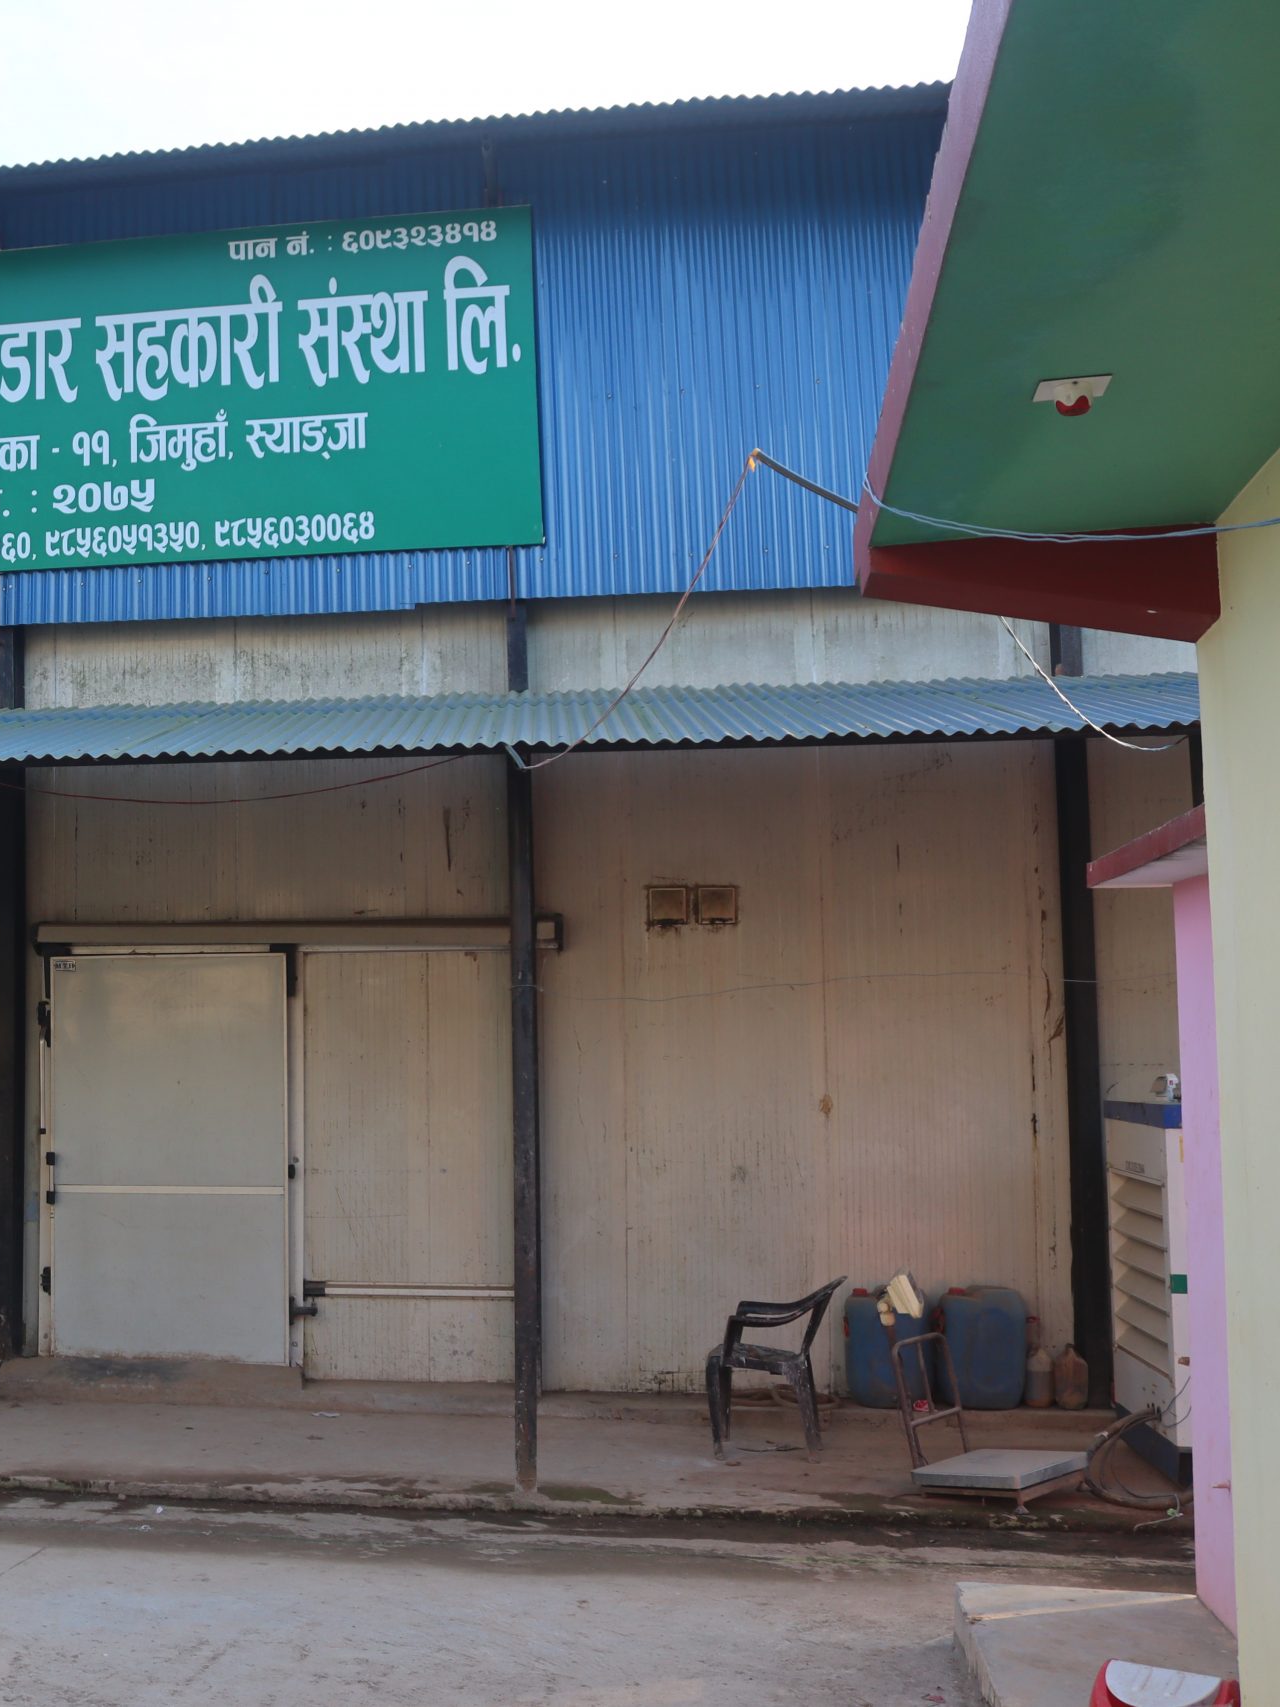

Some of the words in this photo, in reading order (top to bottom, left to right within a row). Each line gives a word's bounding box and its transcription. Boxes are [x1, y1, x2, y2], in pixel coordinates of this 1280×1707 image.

[228, 236, 278, 261] पान
[286, 230, 315, 256] नं.
[341, 220, 497, 254] ६०९३२३४१४
[95, 274, 283, 402] सहकारी
[297, 276, 429, 387] संस्था
[443, 255, 522, 375] लि.
[129, 408, 234, 472] जिमुहाँ,
[245, 411, 369, 461] स्याङ्जा
[52, 478, 155, 514] २०७५
[214, 511, 375, 550] ९८५६०३००६४
